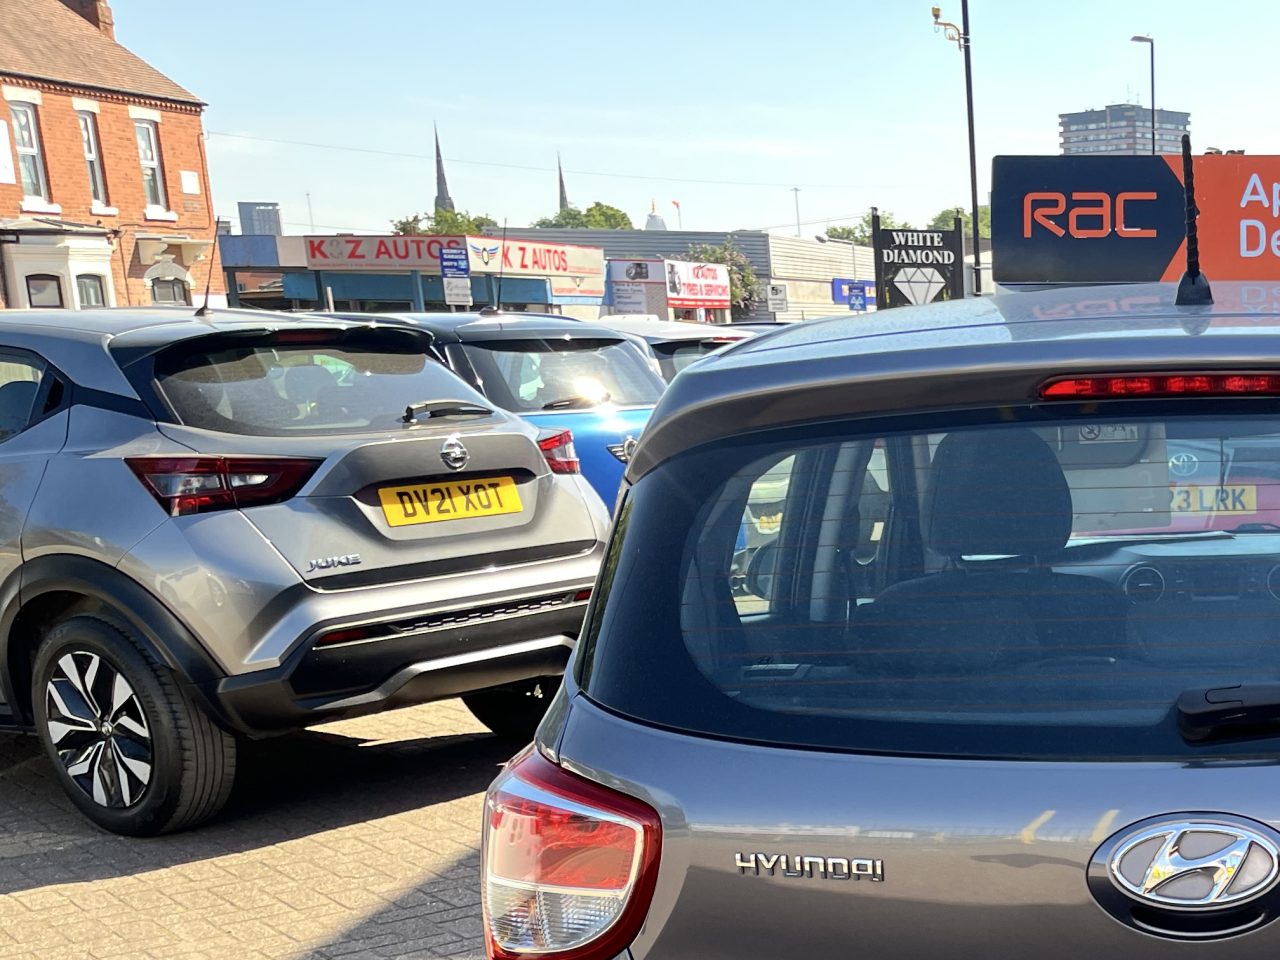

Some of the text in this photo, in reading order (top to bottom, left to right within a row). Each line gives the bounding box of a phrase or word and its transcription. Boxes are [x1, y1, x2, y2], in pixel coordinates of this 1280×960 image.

[891, 231, 943, 247] WHITE
[532, 248, 567, 272] AUTOS
[882, 249, 955, 264] DIAMOND
[396, 483, 504, 518] DV21 XOT
[1199, 487, 1247, 511] LRK
[306, 553, 362, 573] JUKE
[735, 852, 885, 882] HYUNDAI
